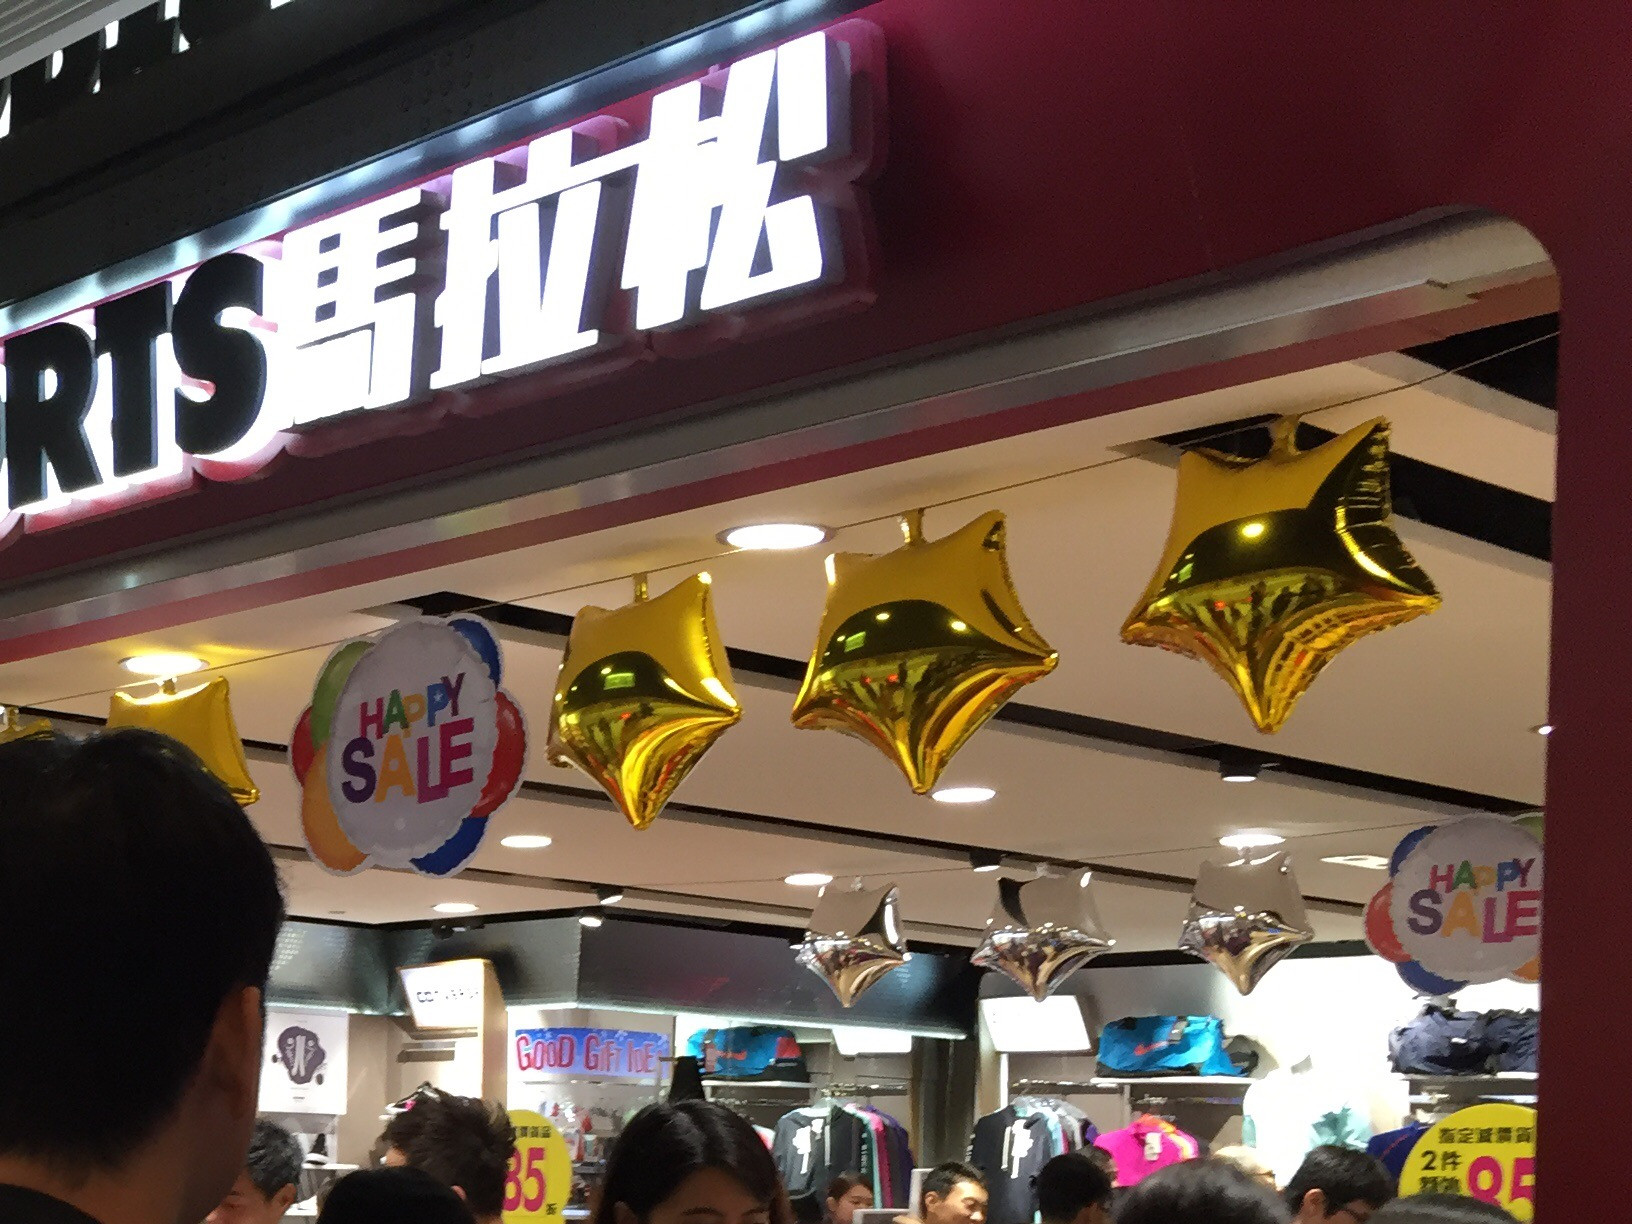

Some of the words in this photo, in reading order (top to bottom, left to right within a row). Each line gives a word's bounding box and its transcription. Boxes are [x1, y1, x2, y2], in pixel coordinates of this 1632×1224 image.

[279, 30, 829, 426] 馬拉松
[359, 672, 466, 740] HAPPY
[341, 717, 475, 804] SALE
[1428, 857, 1536, 894] HAPPY
[1406, 889, 1542, 944] SALE
[516, 1034, 576, 1072] GOOD
